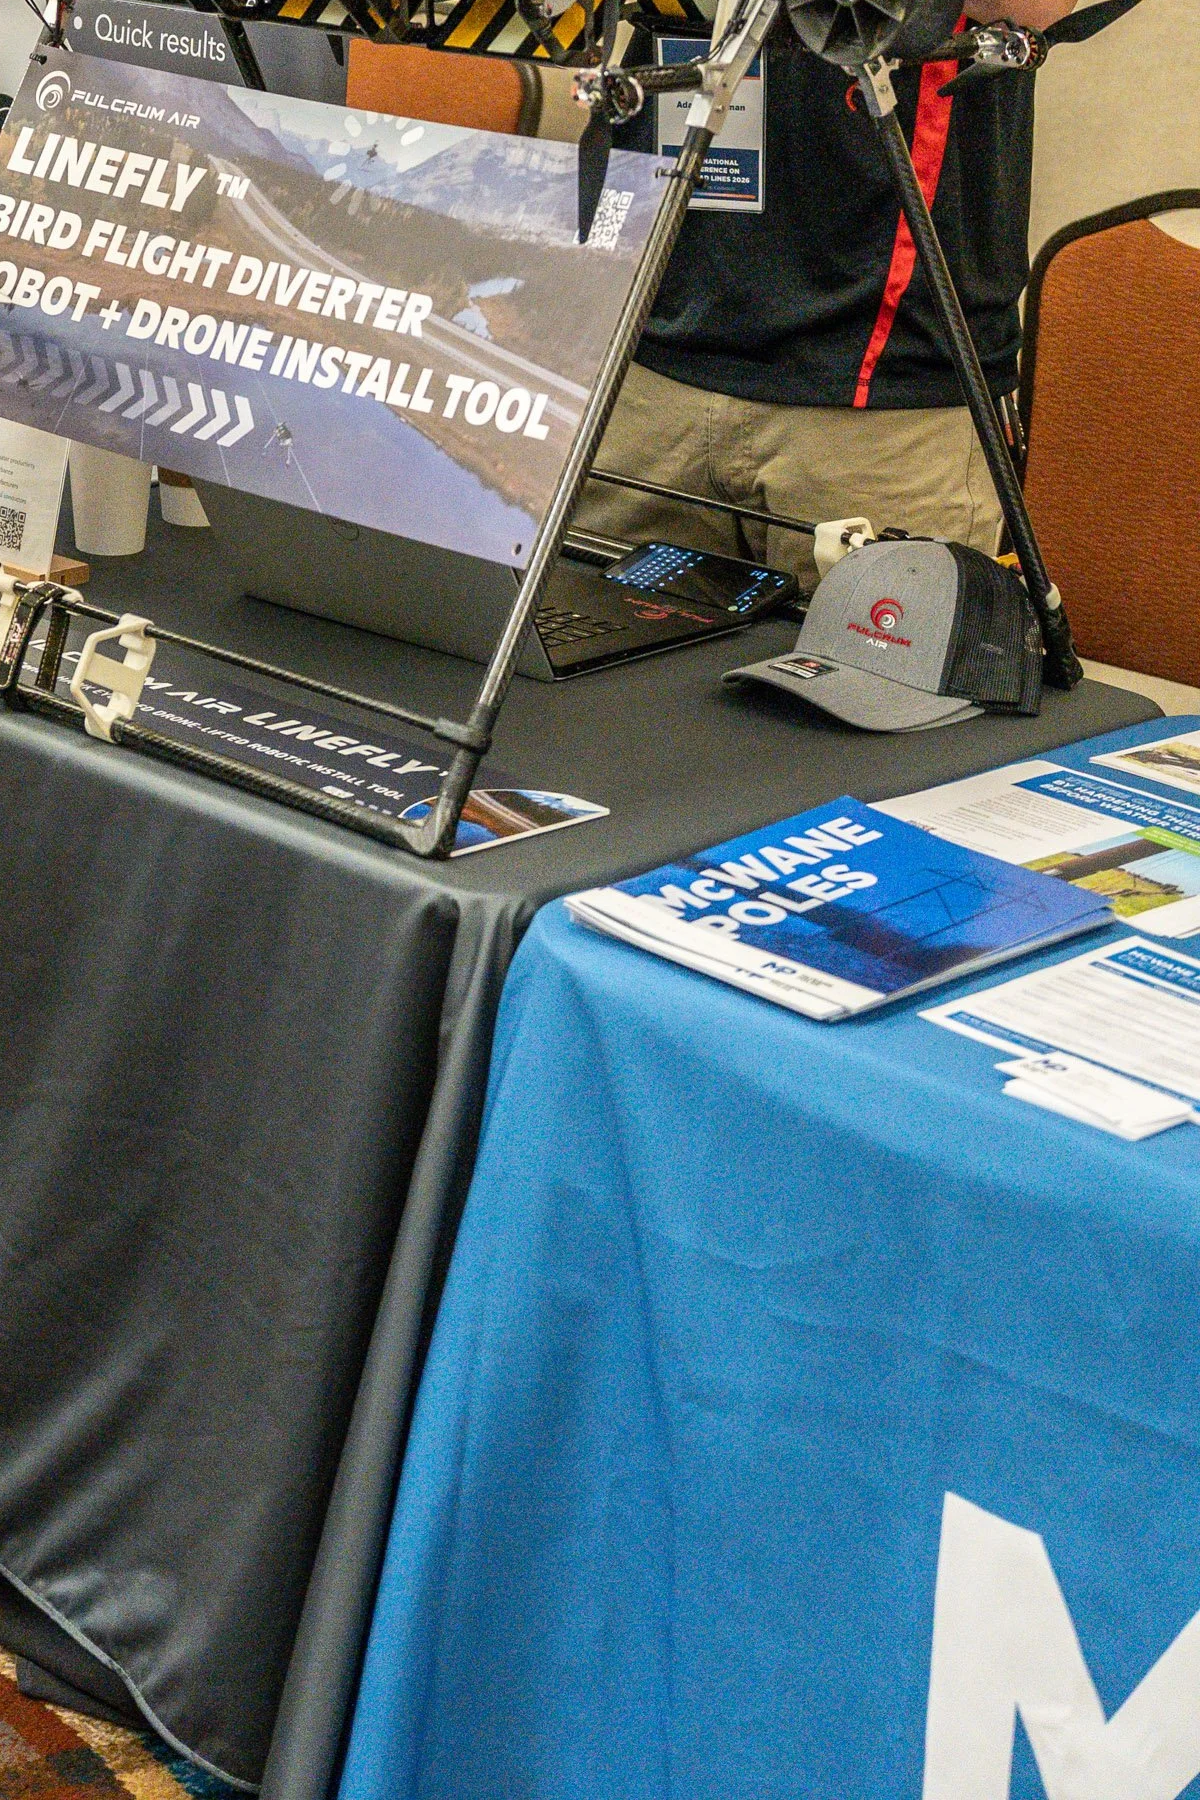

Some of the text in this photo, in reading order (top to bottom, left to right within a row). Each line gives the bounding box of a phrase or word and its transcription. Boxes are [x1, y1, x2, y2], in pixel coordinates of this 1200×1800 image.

[94, 13, 227, 62] Quick results
[71, 89, 201, 130] FULCRUM AIR
[6, 126, 209, 213] LINEFLY
[700, 166, 740, 175] ERENCE ON
[702, 157, 739, 167] NATIONAL
[711, 175, 731, 183] LINES
[731, 176, 750, 184] 2026
[81, 218, 234, 289] FLIGHT
[226, 254, 434, 339] DIVERTER
[98, 299, 123, 331] +
[125, 298, 275, 371] DRONE
[268, 334, 435, 414] INSTALL
[442, 372, 551, 441] TOOL
[847, 622, 912, 647] FULCRUM
[866, 637, 888, 650] AIR
[165, 691, 243, 716] AIR
[152, 706, 250, 746] DRONE-LIFTED
[247, 742, 311, 768] ROBOTIC
[307, 762, 367, 787] INSTALL
[366, 782, 405, 800] TOOL
[1039, 783, 1101, 804] BEFORE
[1100, 801, 1172, 827] WEATHER
[1051, 778, 1075, 789] BY
[1075, 785, 1160, 817] HARDENING
[692, 863, 879, 941] POLES
